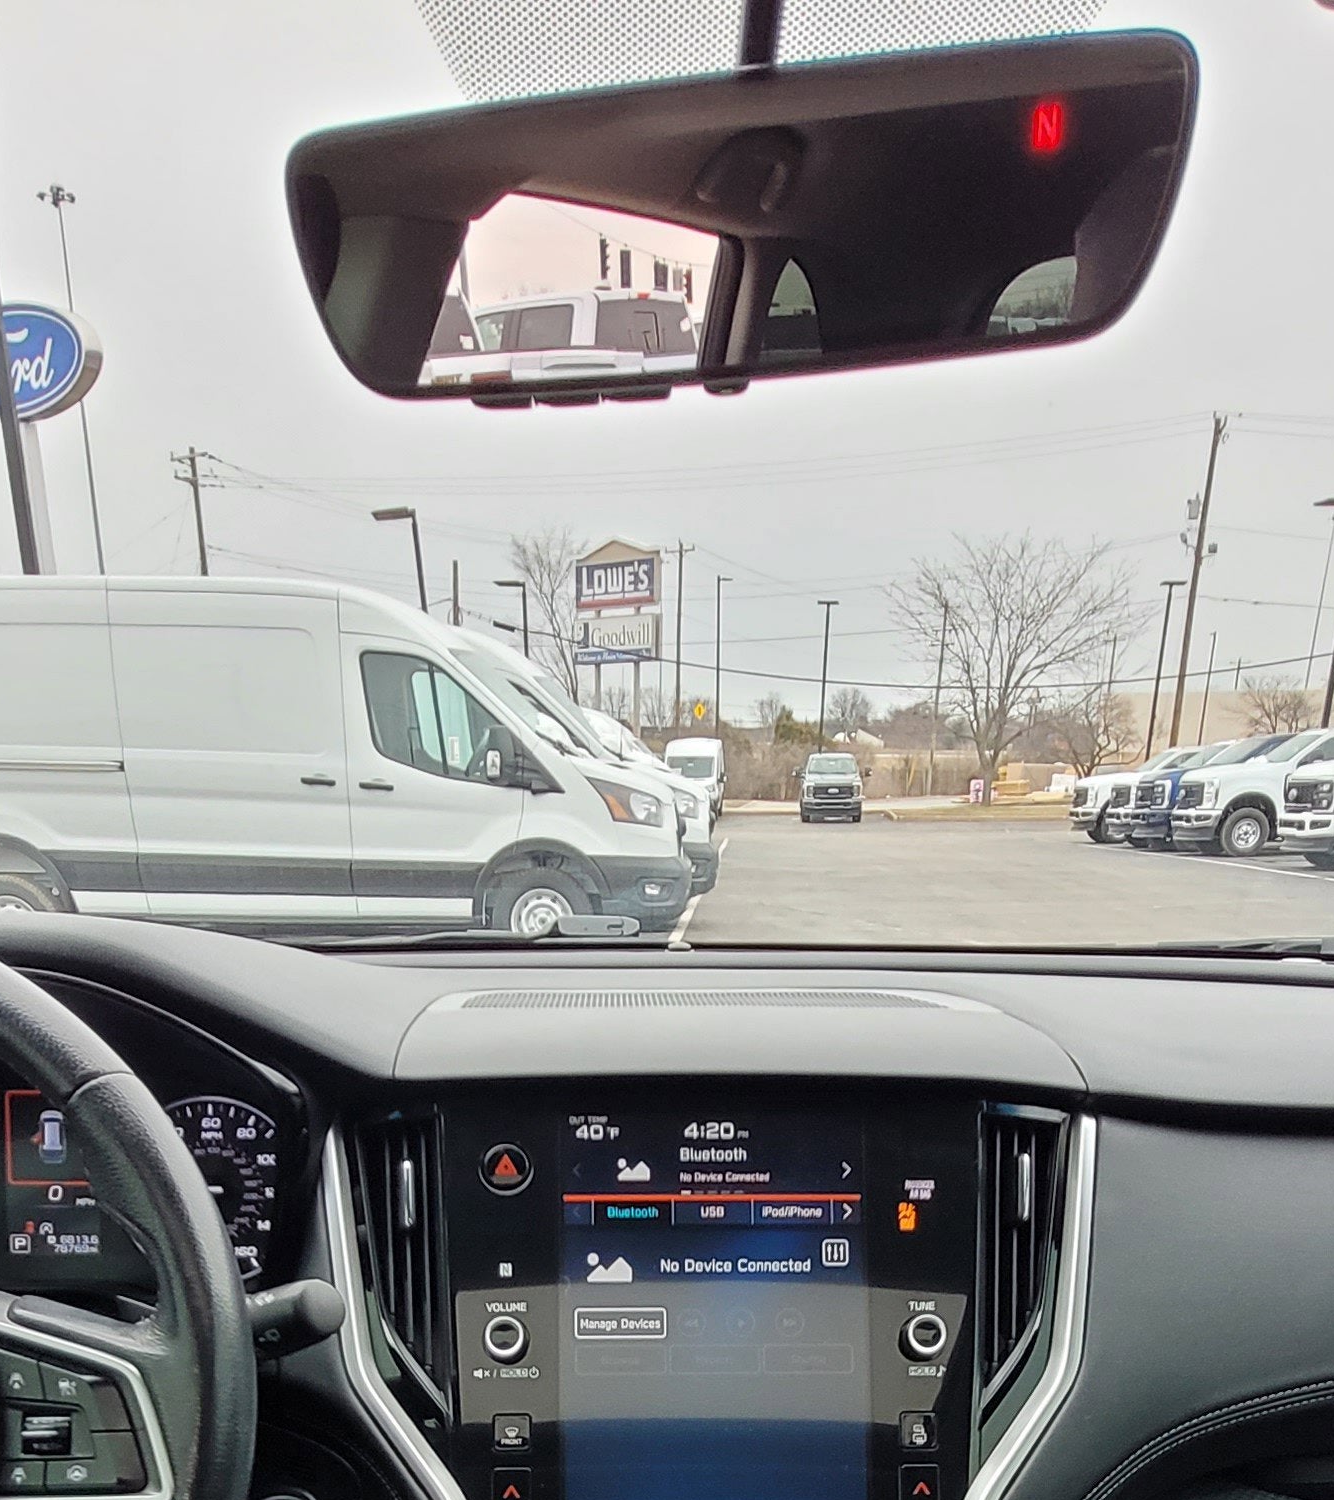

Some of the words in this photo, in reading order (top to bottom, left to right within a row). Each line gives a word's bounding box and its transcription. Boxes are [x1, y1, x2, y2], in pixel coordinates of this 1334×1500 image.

[1034, 102, 1061, 150] N
[581, 561, 649, 596] LOWE'S
[591, 622, 651, 648] Goodwill
[201, 1117, 222, 1129] 60
[236, 1127, 257, 1140] 80
[683, 1121, 735, 1141] 4:20
[679, 1147, 748, 1162] Bluetooth
[679, 1171, 693, 1184] No
[694, 1171, 724, 1183] Device
[725, 1170, 770, 1184] Connected
[48, 1185, 63, 1202] 0
[607, 1205, 659, 1218] Bluetooth
[700, 1205, 725, 1218] USB
[761, 1205, 822, 1219] iPod/iPhone
[14, 1238, 27, 1250] P
[234, 1245, 258, 1257] 150
[660, 1258, 680, 1273] No
[684, 1258, 732, 1274] Device
[737, 1257, 812, 1273] Connected
[485, 1301, 527, 1313] VOLUME
[908, 1301, 935, 1311] TUNE
[580, 1318, 618, 1331] Manage
[621, 1317, 662, 1330] Devices
